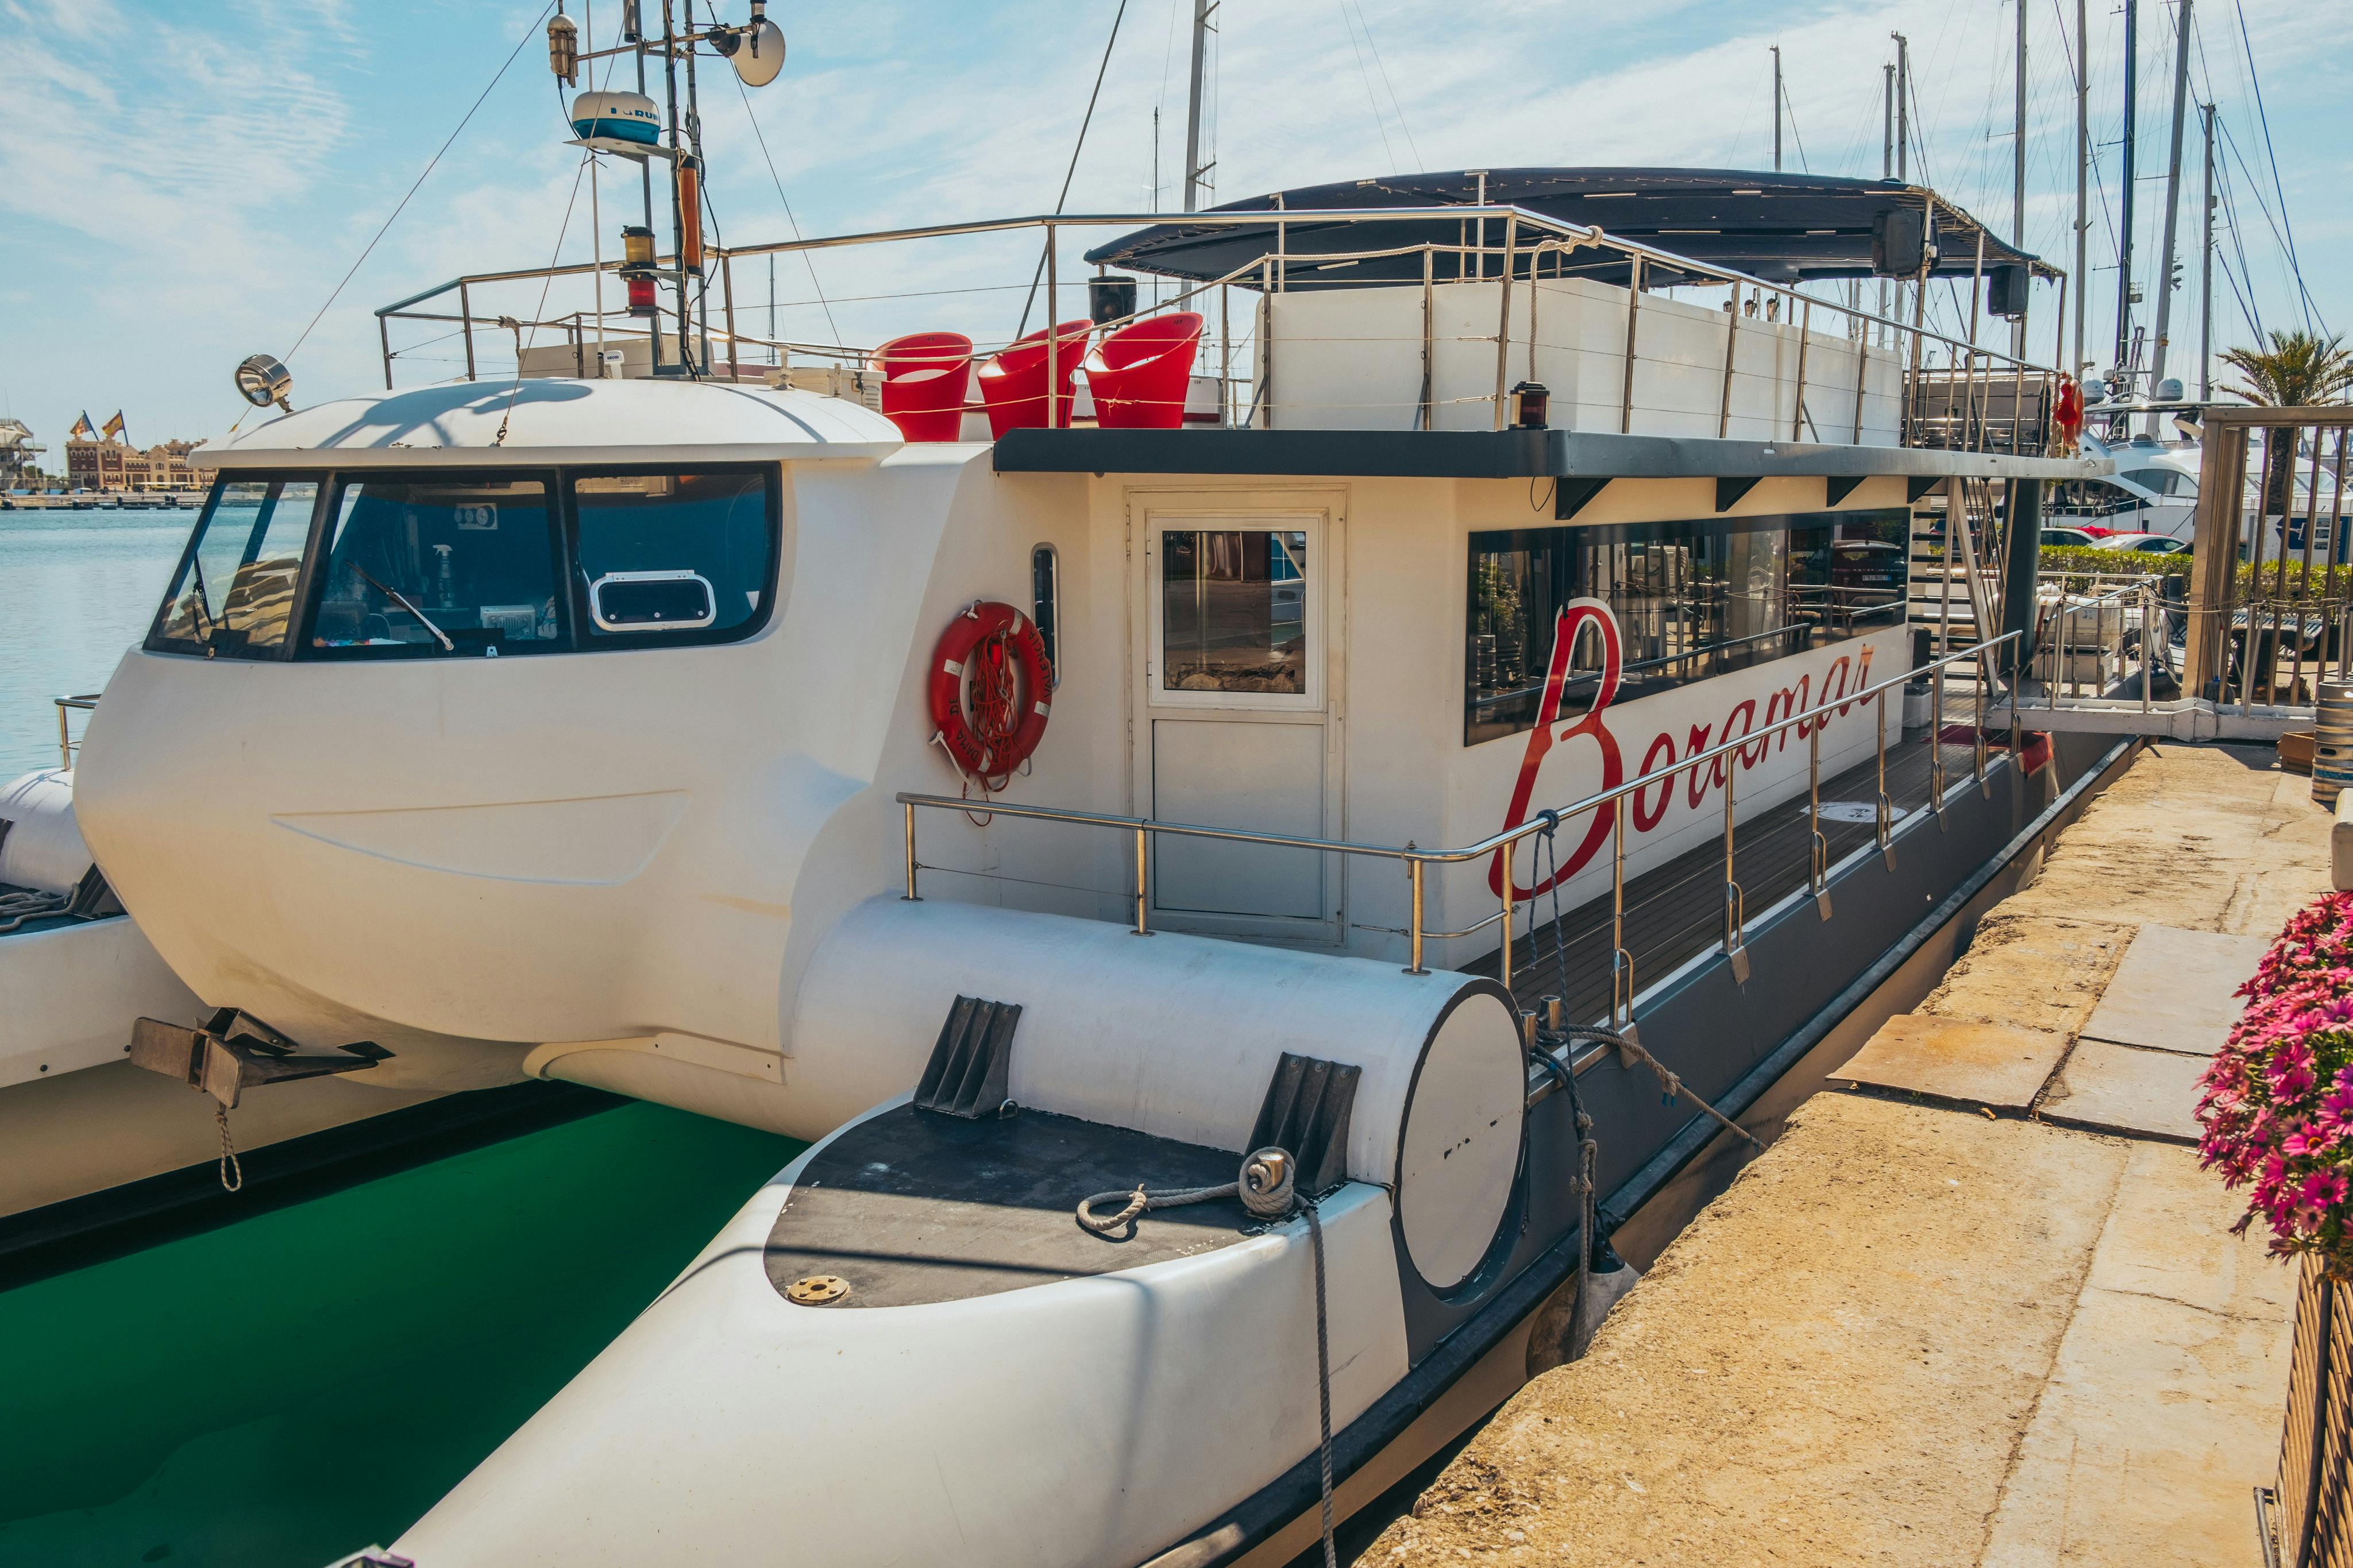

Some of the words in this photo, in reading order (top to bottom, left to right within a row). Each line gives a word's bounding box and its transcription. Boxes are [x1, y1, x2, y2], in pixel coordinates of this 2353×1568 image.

[1027, 629, 1052, 698] VALENCIA
[949, 697, 959, 717] DE
[956, 728, 980, 762] DAMA
[1488, 597, 1877, 901] Boramar
